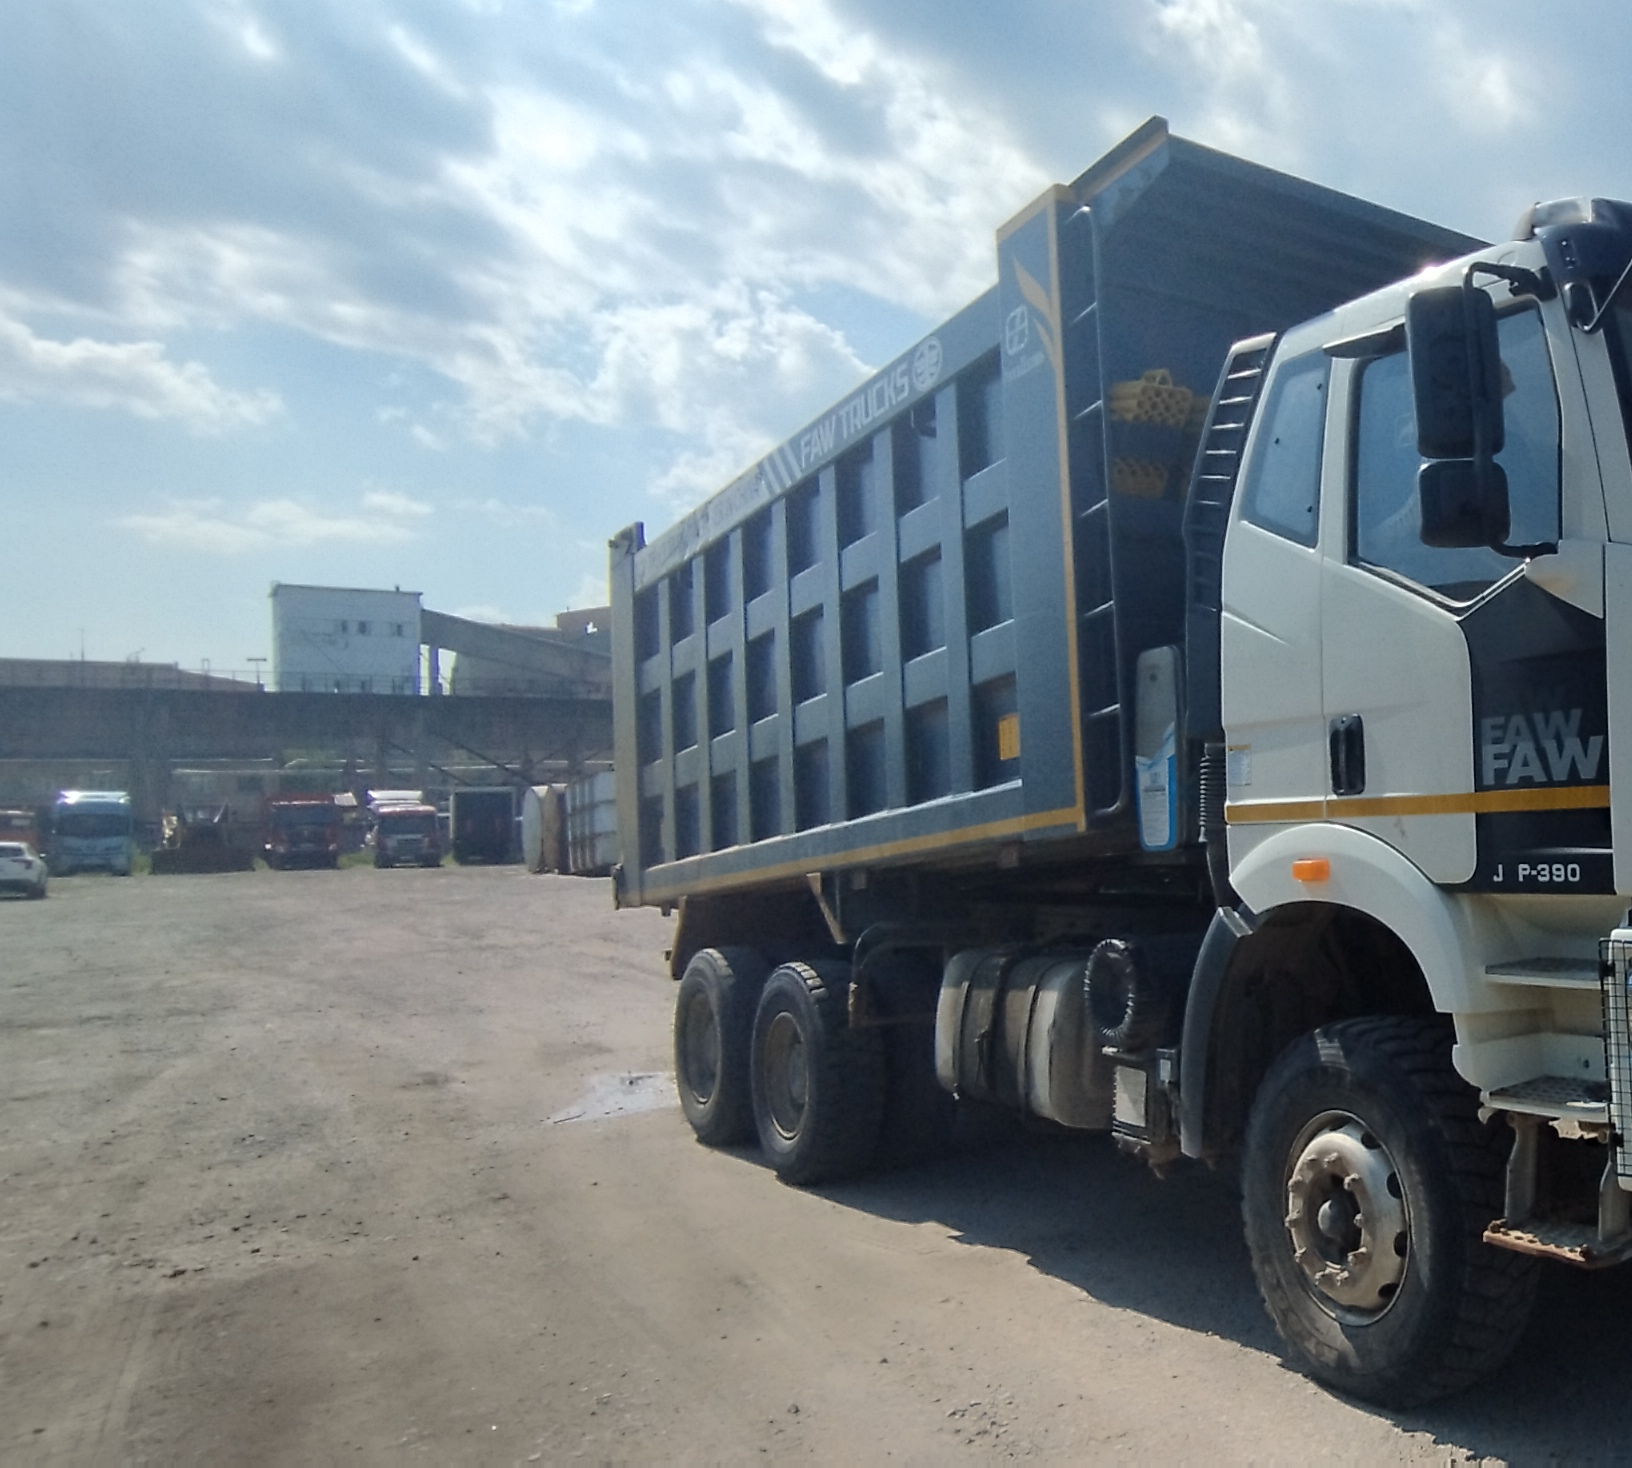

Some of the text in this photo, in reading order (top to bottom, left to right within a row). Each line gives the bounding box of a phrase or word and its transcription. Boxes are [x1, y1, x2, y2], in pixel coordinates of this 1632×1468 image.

[801, 362, 909, 468] FAW TRUCKS
[1482, 735, 1604, 786] FAW
